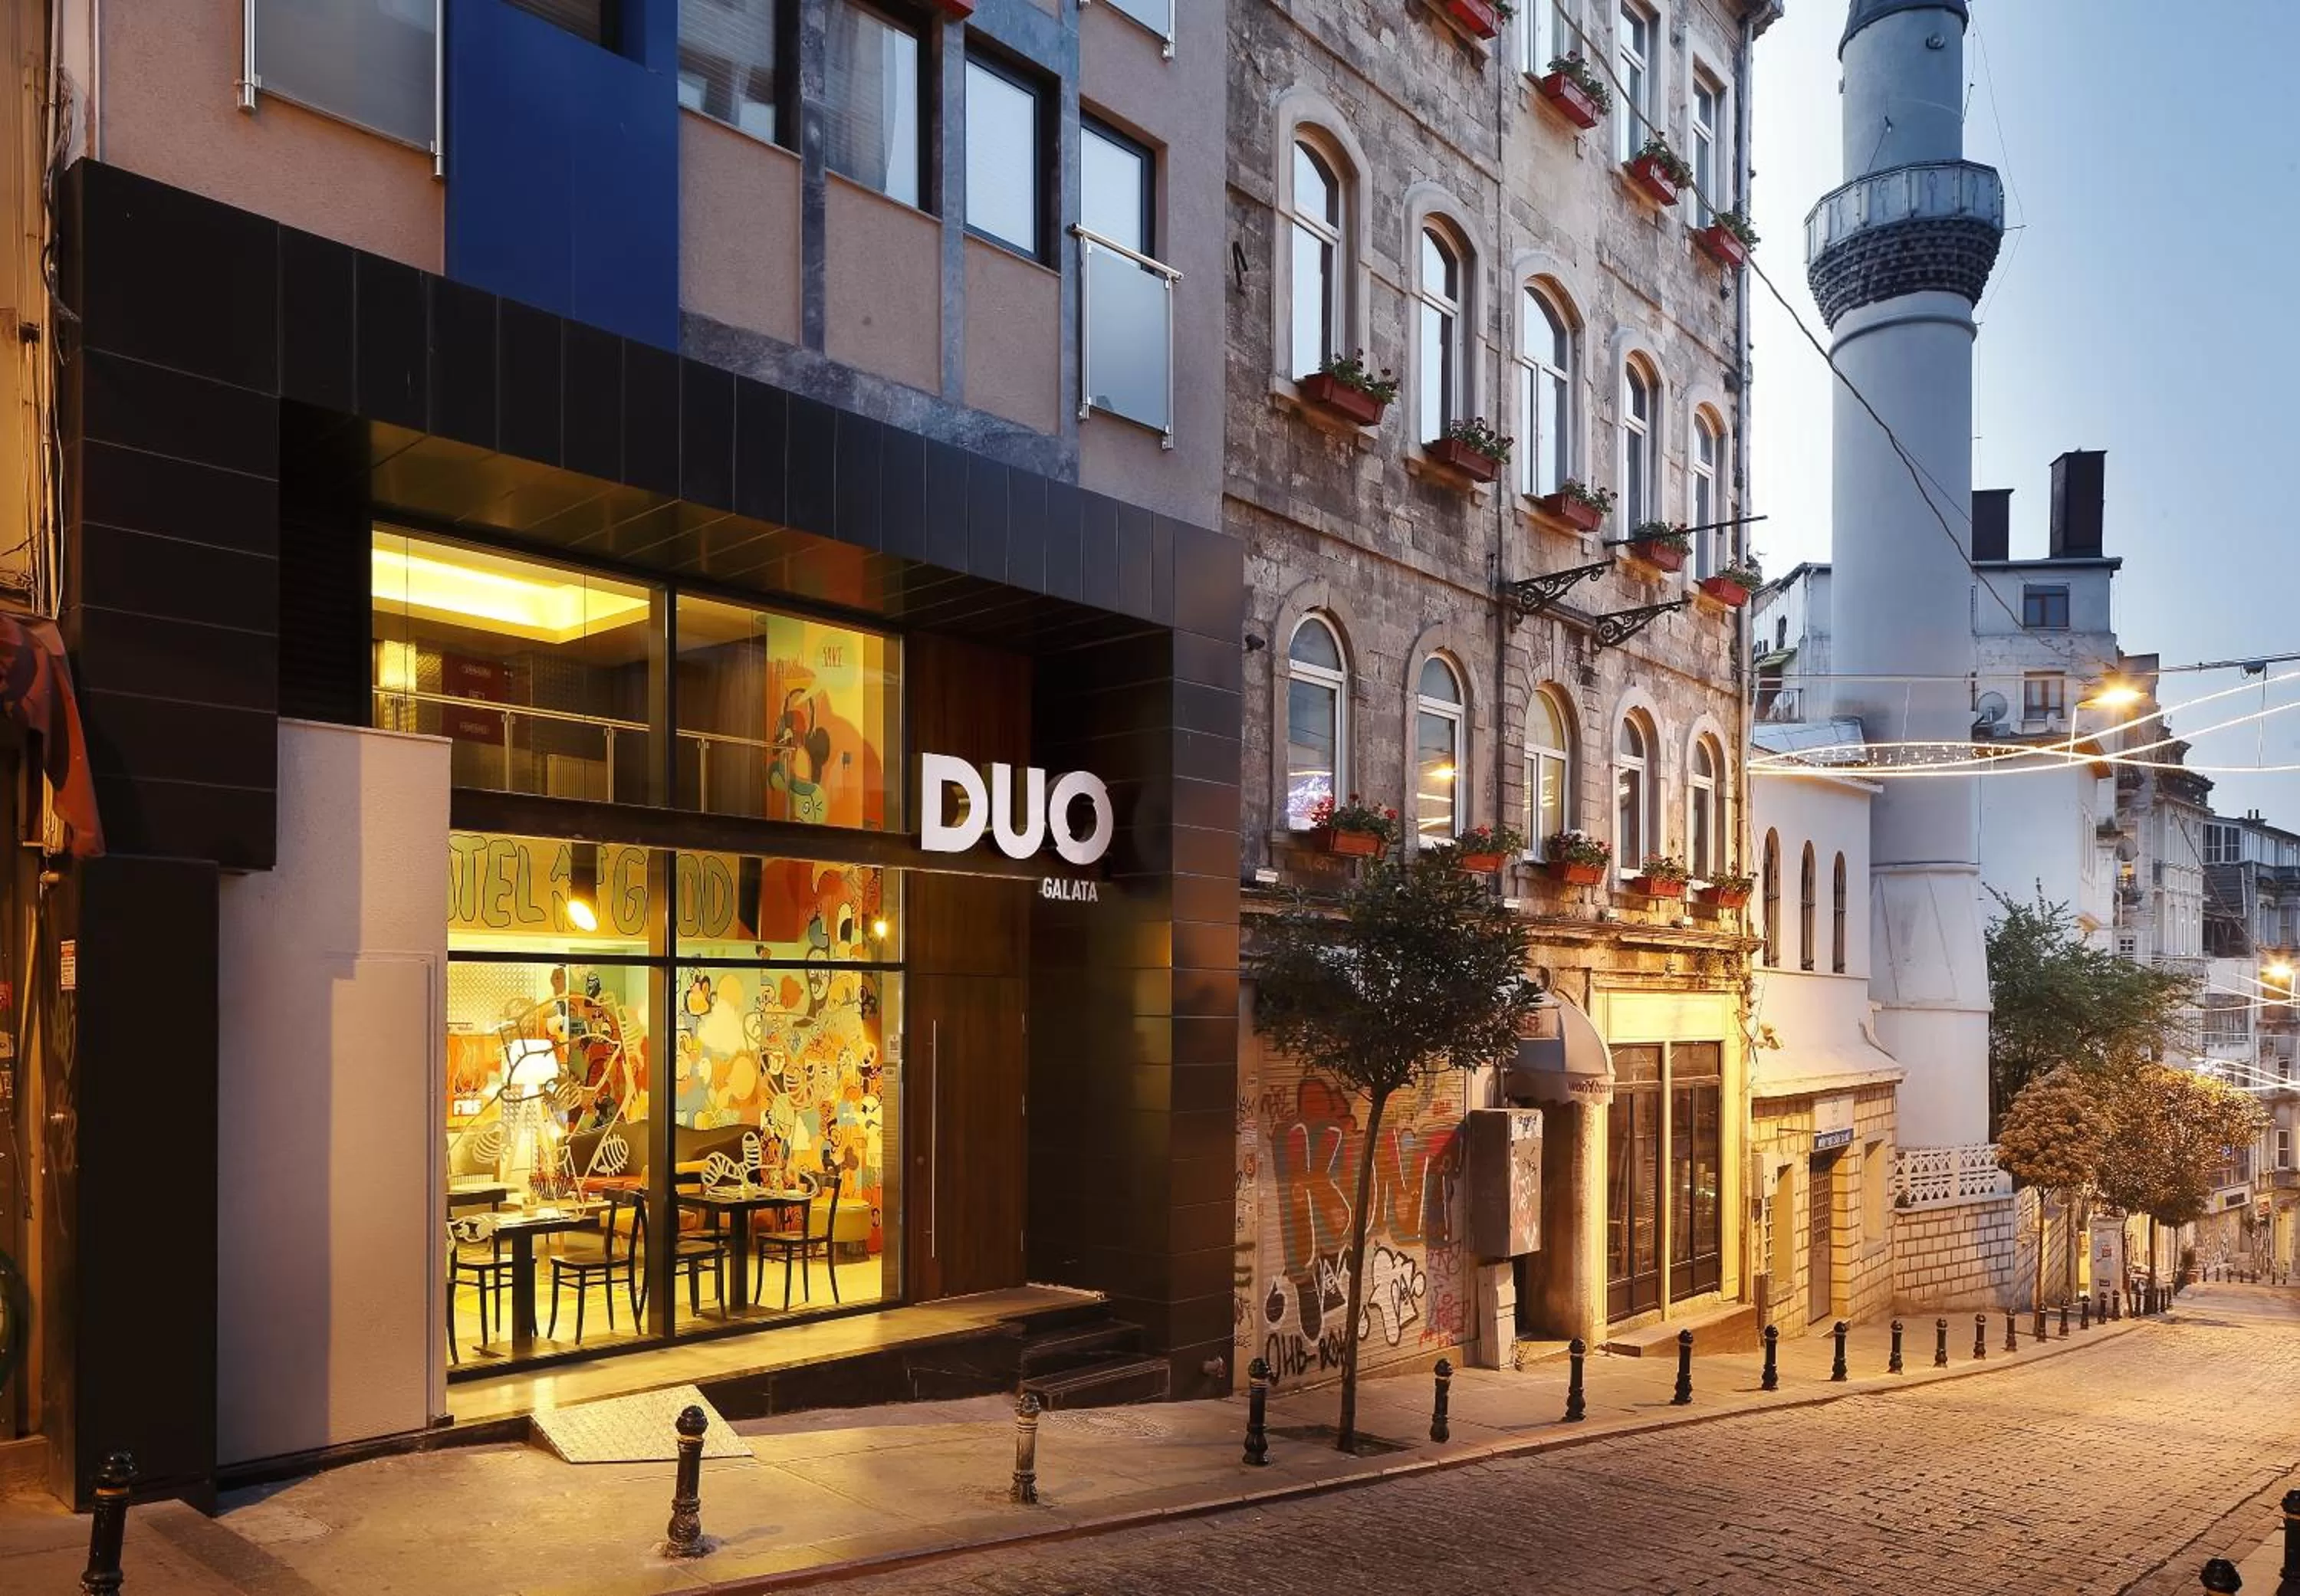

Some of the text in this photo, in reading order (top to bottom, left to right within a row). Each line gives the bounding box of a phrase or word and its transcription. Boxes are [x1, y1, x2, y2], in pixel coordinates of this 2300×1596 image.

[922, 752, 1113, 865] DUO
[448, 835, 547, 928] TEL
[612, 848, 732, 938] GOD
[1042, 877, 1099, 901] GALATA
